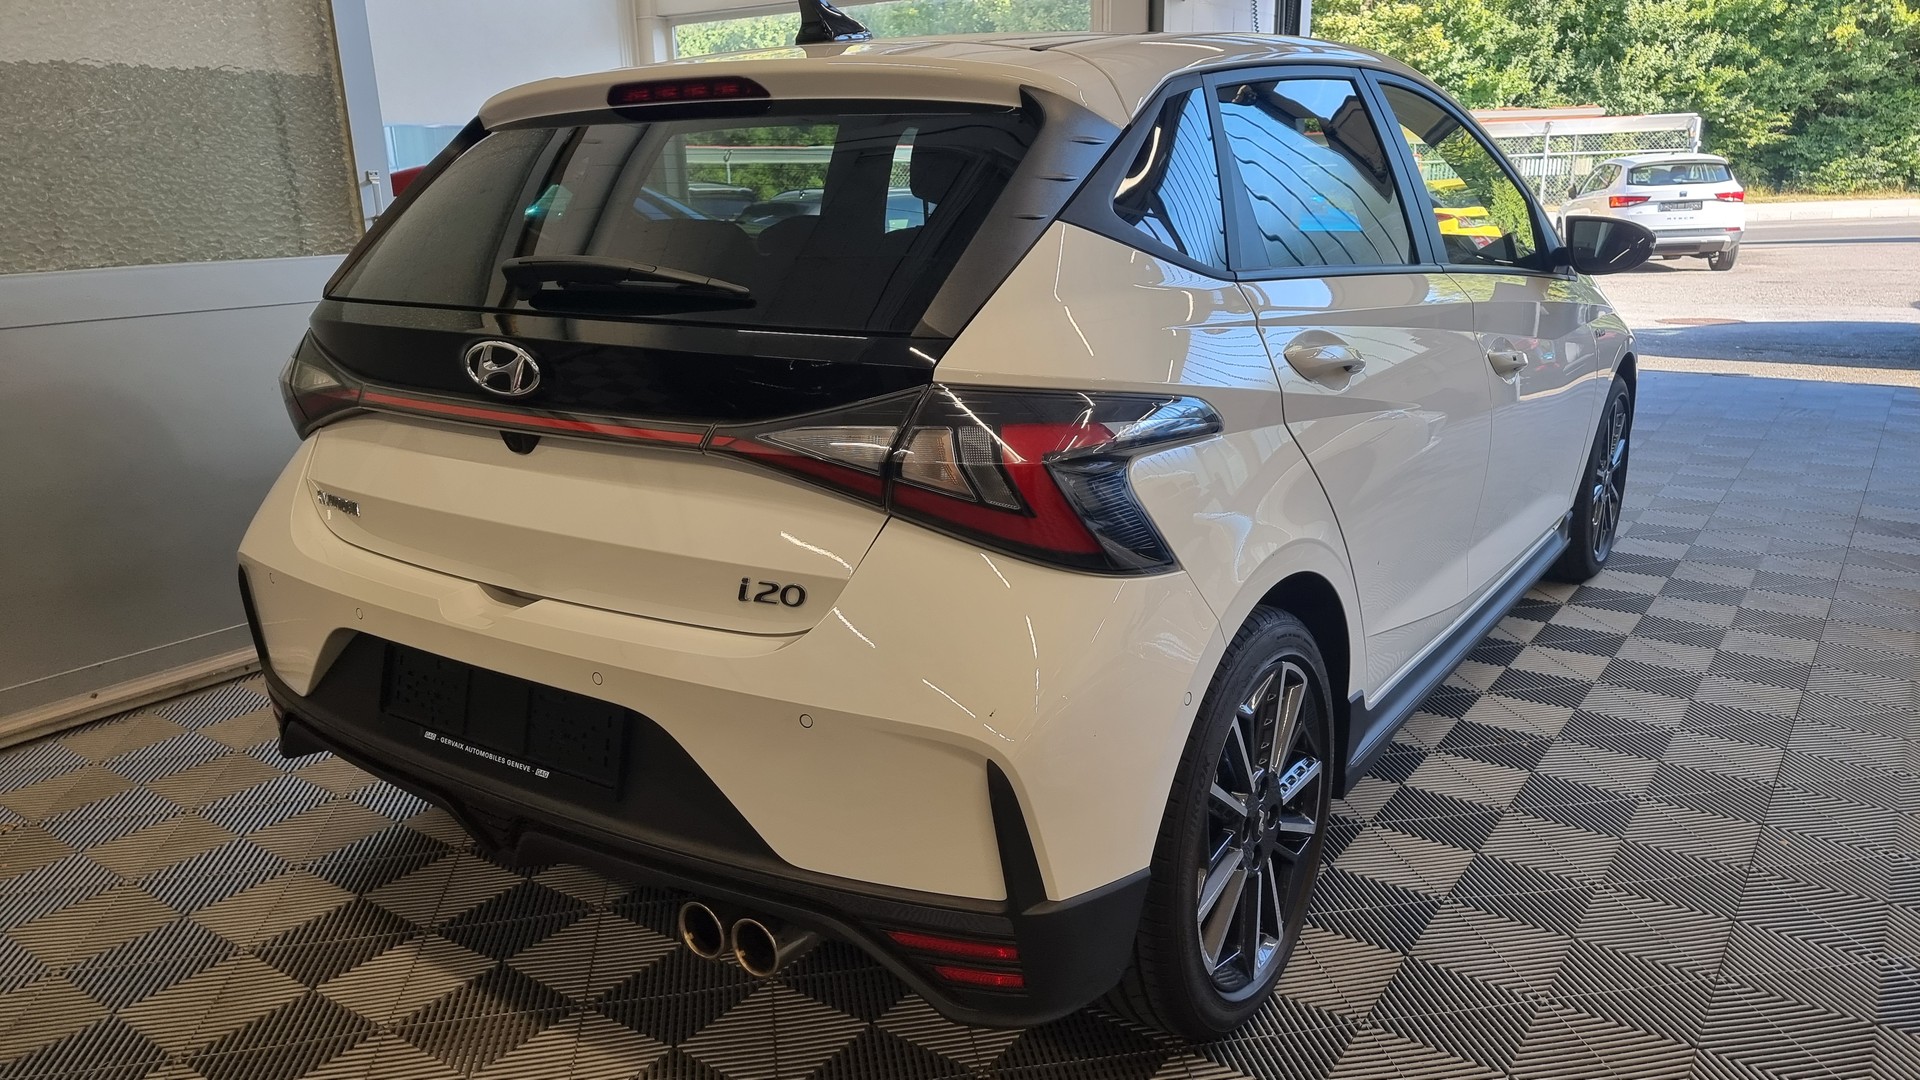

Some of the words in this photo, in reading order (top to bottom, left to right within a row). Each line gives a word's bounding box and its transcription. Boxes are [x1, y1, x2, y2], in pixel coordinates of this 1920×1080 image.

[738, 577, 807, 607] i20
[440, 737, 464, 750] GERVAIX
[465, 746, 505, 764] AUTOMOBILES
[507, 760, 530, 772] GENEVE
